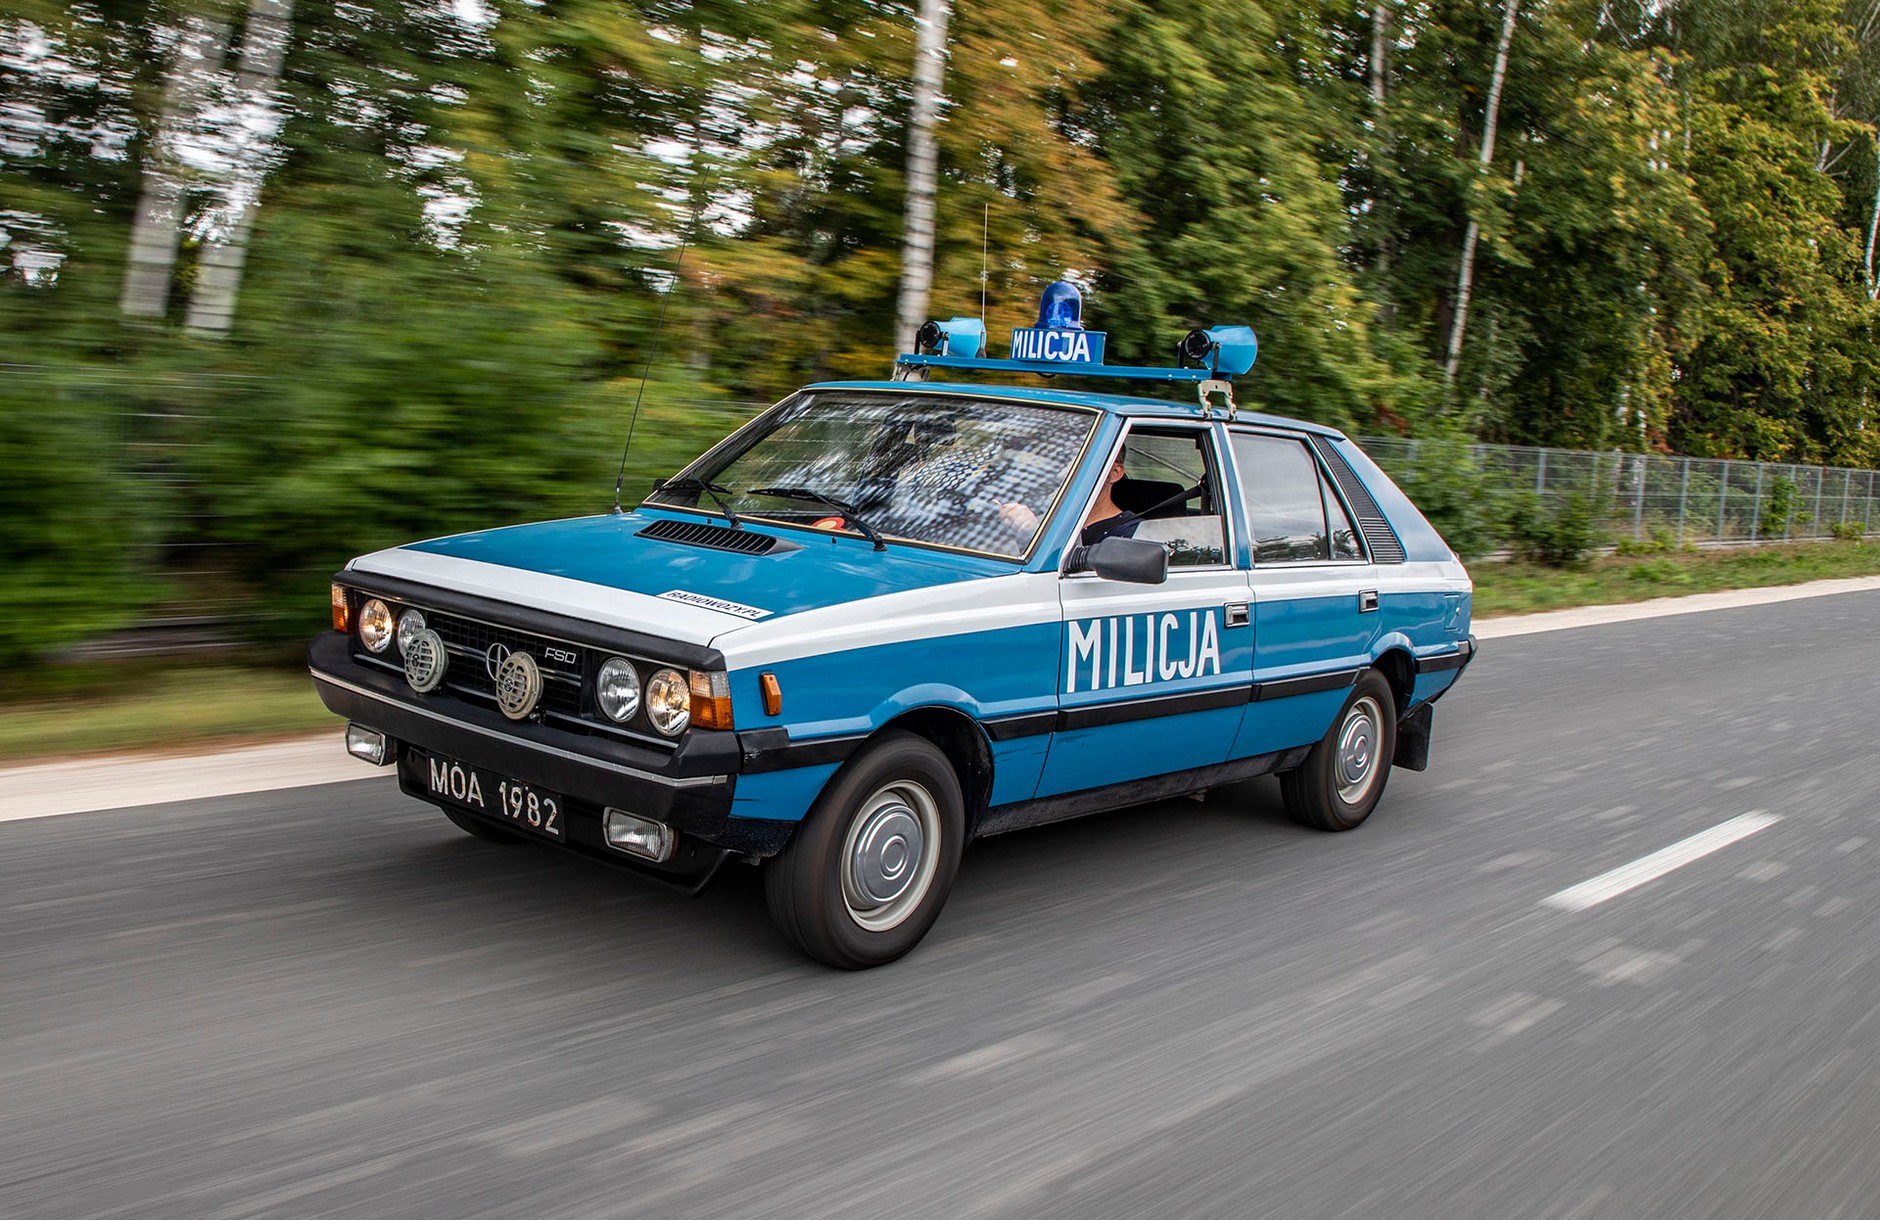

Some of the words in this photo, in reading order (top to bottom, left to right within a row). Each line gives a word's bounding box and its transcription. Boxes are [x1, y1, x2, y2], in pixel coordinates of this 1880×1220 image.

[1011, 330, 1091, 362] MILICJA
[666, 591, 761, 618] RADIOWOZY.PL
[544, 647, 577, 664] FSO
[1066, 610, 1221, 694] MILICJA
[430, 757, 485, 808] MOA
[499, 781, 559, 836] 1982
